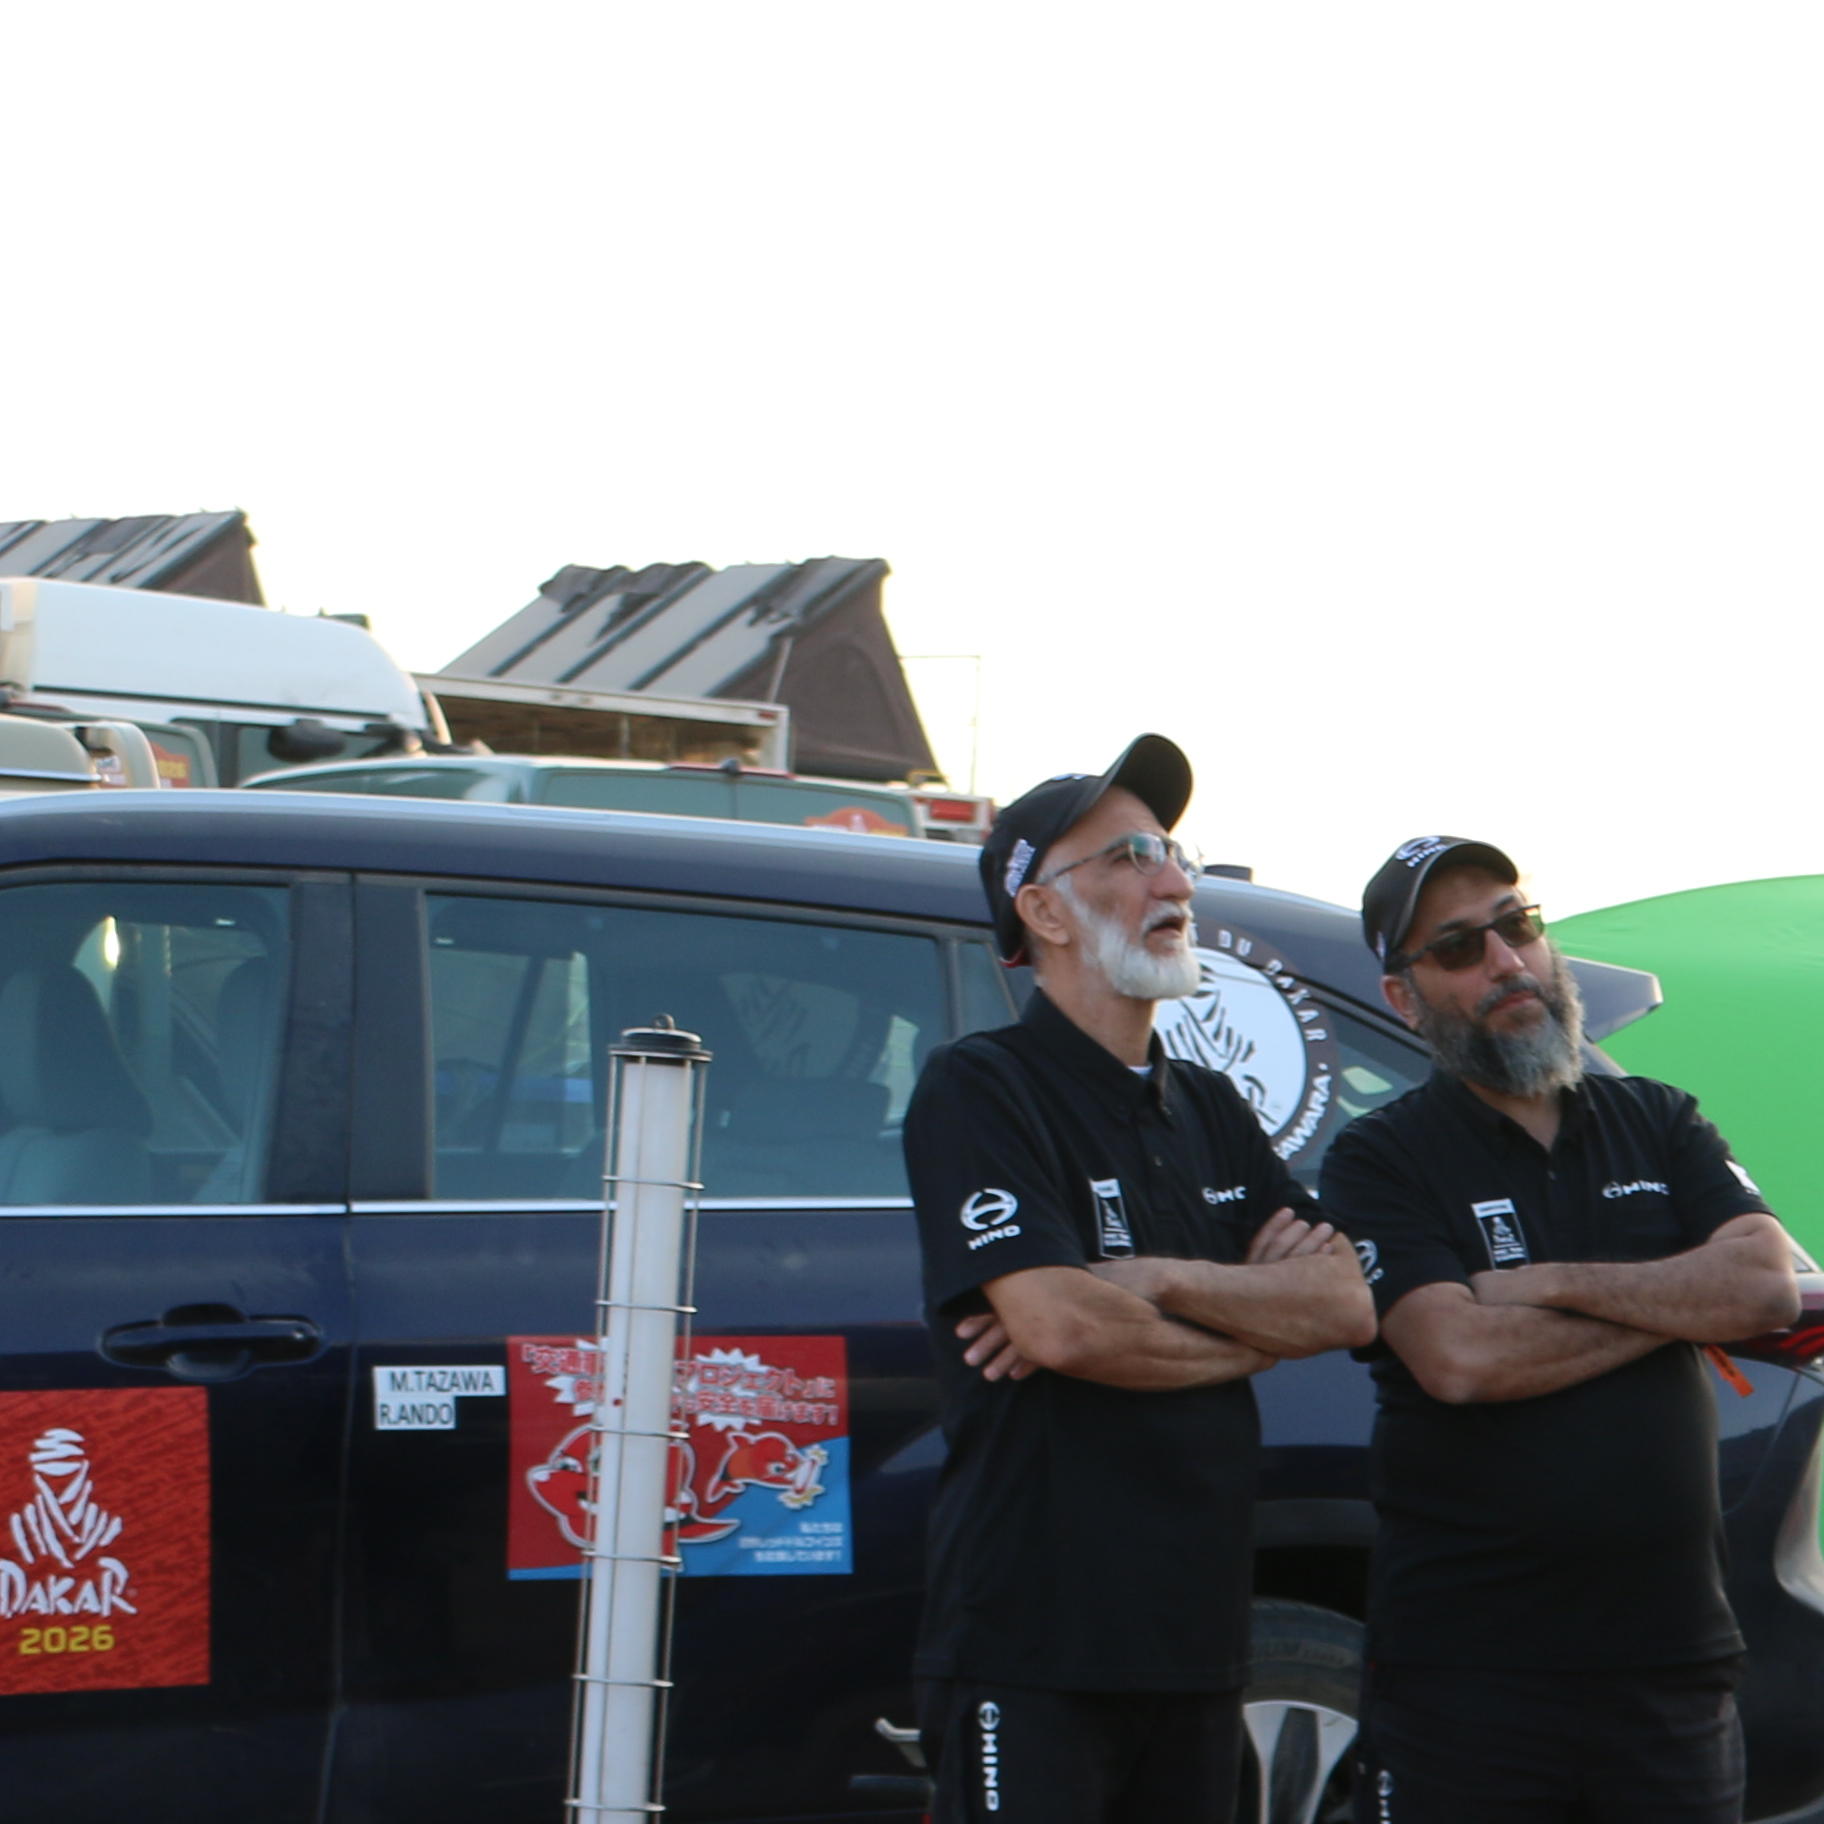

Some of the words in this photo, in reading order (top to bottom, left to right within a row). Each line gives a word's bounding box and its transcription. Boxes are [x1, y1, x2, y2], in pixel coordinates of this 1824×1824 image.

[1217, 929, 1252, 956] DU
[967, 1225, 1021, 1251] HINO
[389, 1370, 495, 1393] M.TAZAWA
[379, 1403, 455, 1425] R.ANDO
[0, 1556, 138, 1619] DAKAR
[19, 1625, 115, 1655] 2026
[981, 1732, 1000, 1812] HINO
